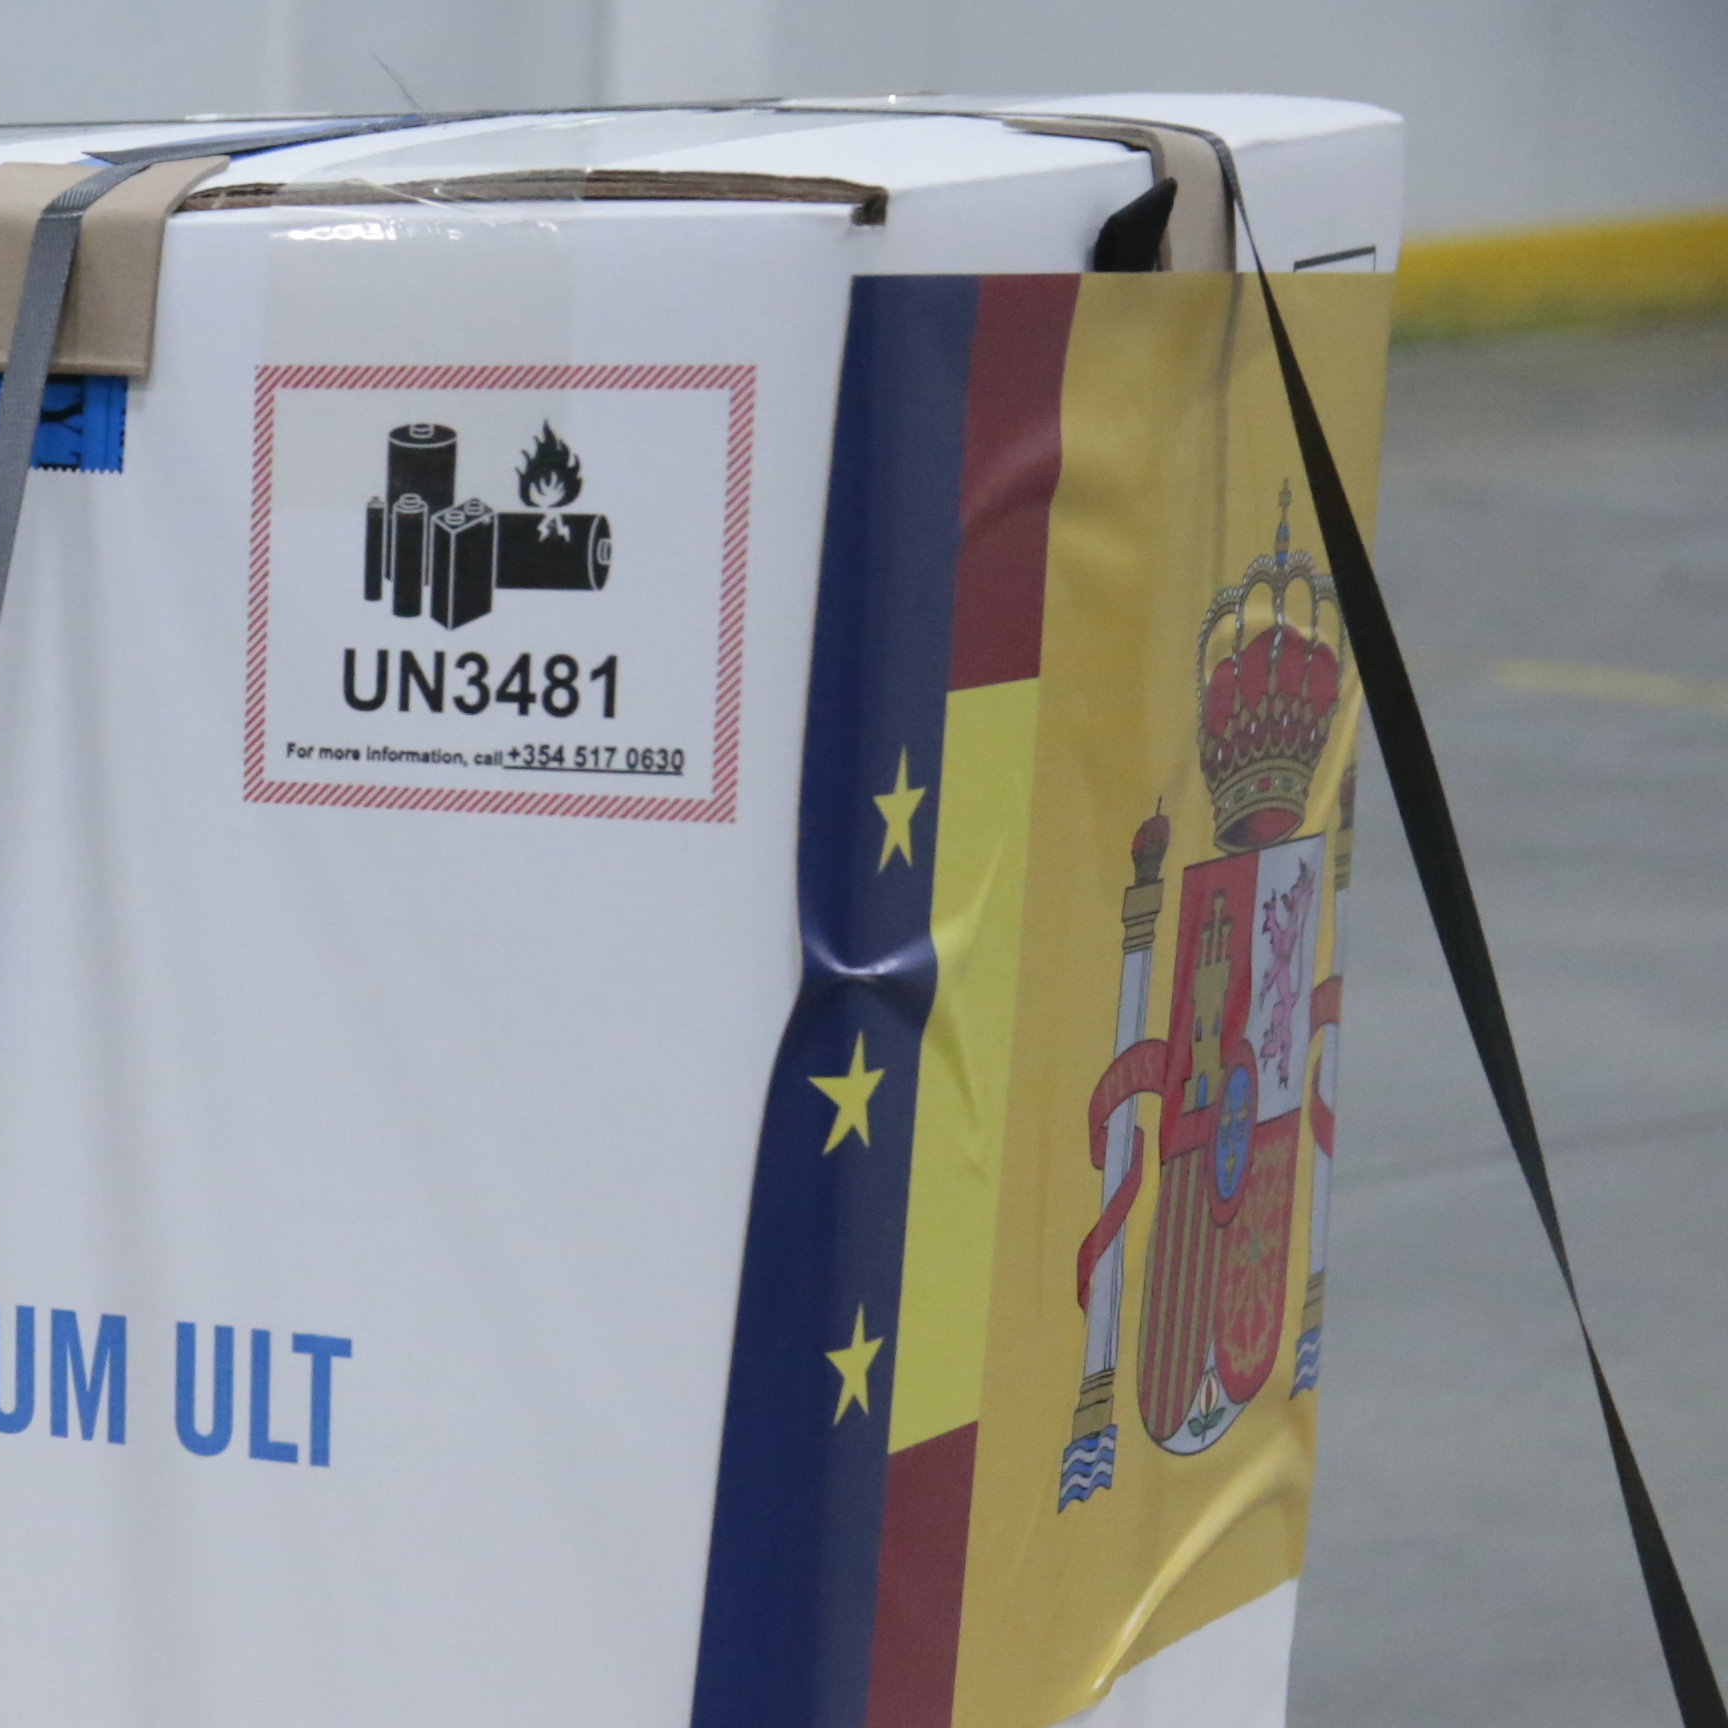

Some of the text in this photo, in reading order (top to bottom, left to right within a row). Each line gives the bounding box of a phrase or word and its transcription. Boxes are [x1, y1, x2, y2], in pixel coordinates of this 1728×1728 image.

[343, 649, 619, 719] UN3481
[286, 741, 314, 759] For
[319, 745, 360, 761] more
[365, 744, 468, 768] information,
[507, 745, 564, 768] +354
[574, 746, 616, 769] 517
[626, 747, 684, 772] 0630
[175, 1320, 352, 1468] ULT
